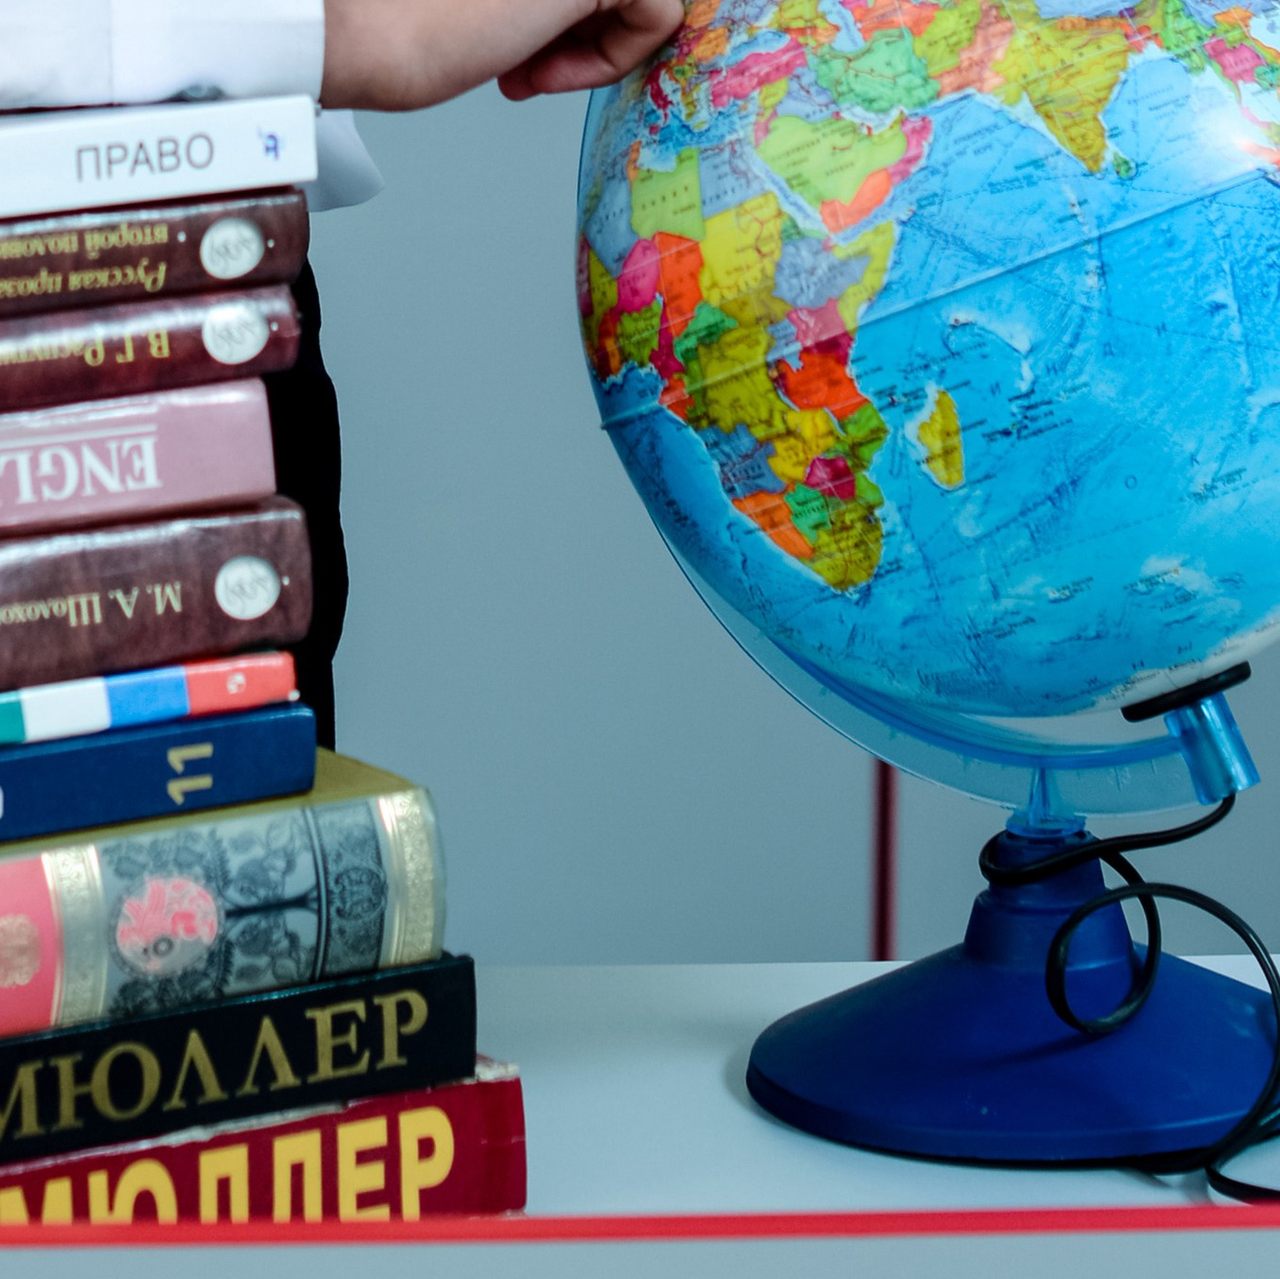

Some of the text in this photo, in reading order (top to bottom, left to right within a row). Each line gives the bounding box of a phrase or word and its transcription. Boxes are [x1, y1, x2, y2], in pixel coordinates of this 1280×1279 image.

[74, 132, 217, 183] ПРАВО
[85, 222, 169, 260] второй
[68, 258, 168, 293] Русская
[107, 587, 141, 620] А.
[146, 580, 183, 616] М.
[166, 742, 214, 806] 11
